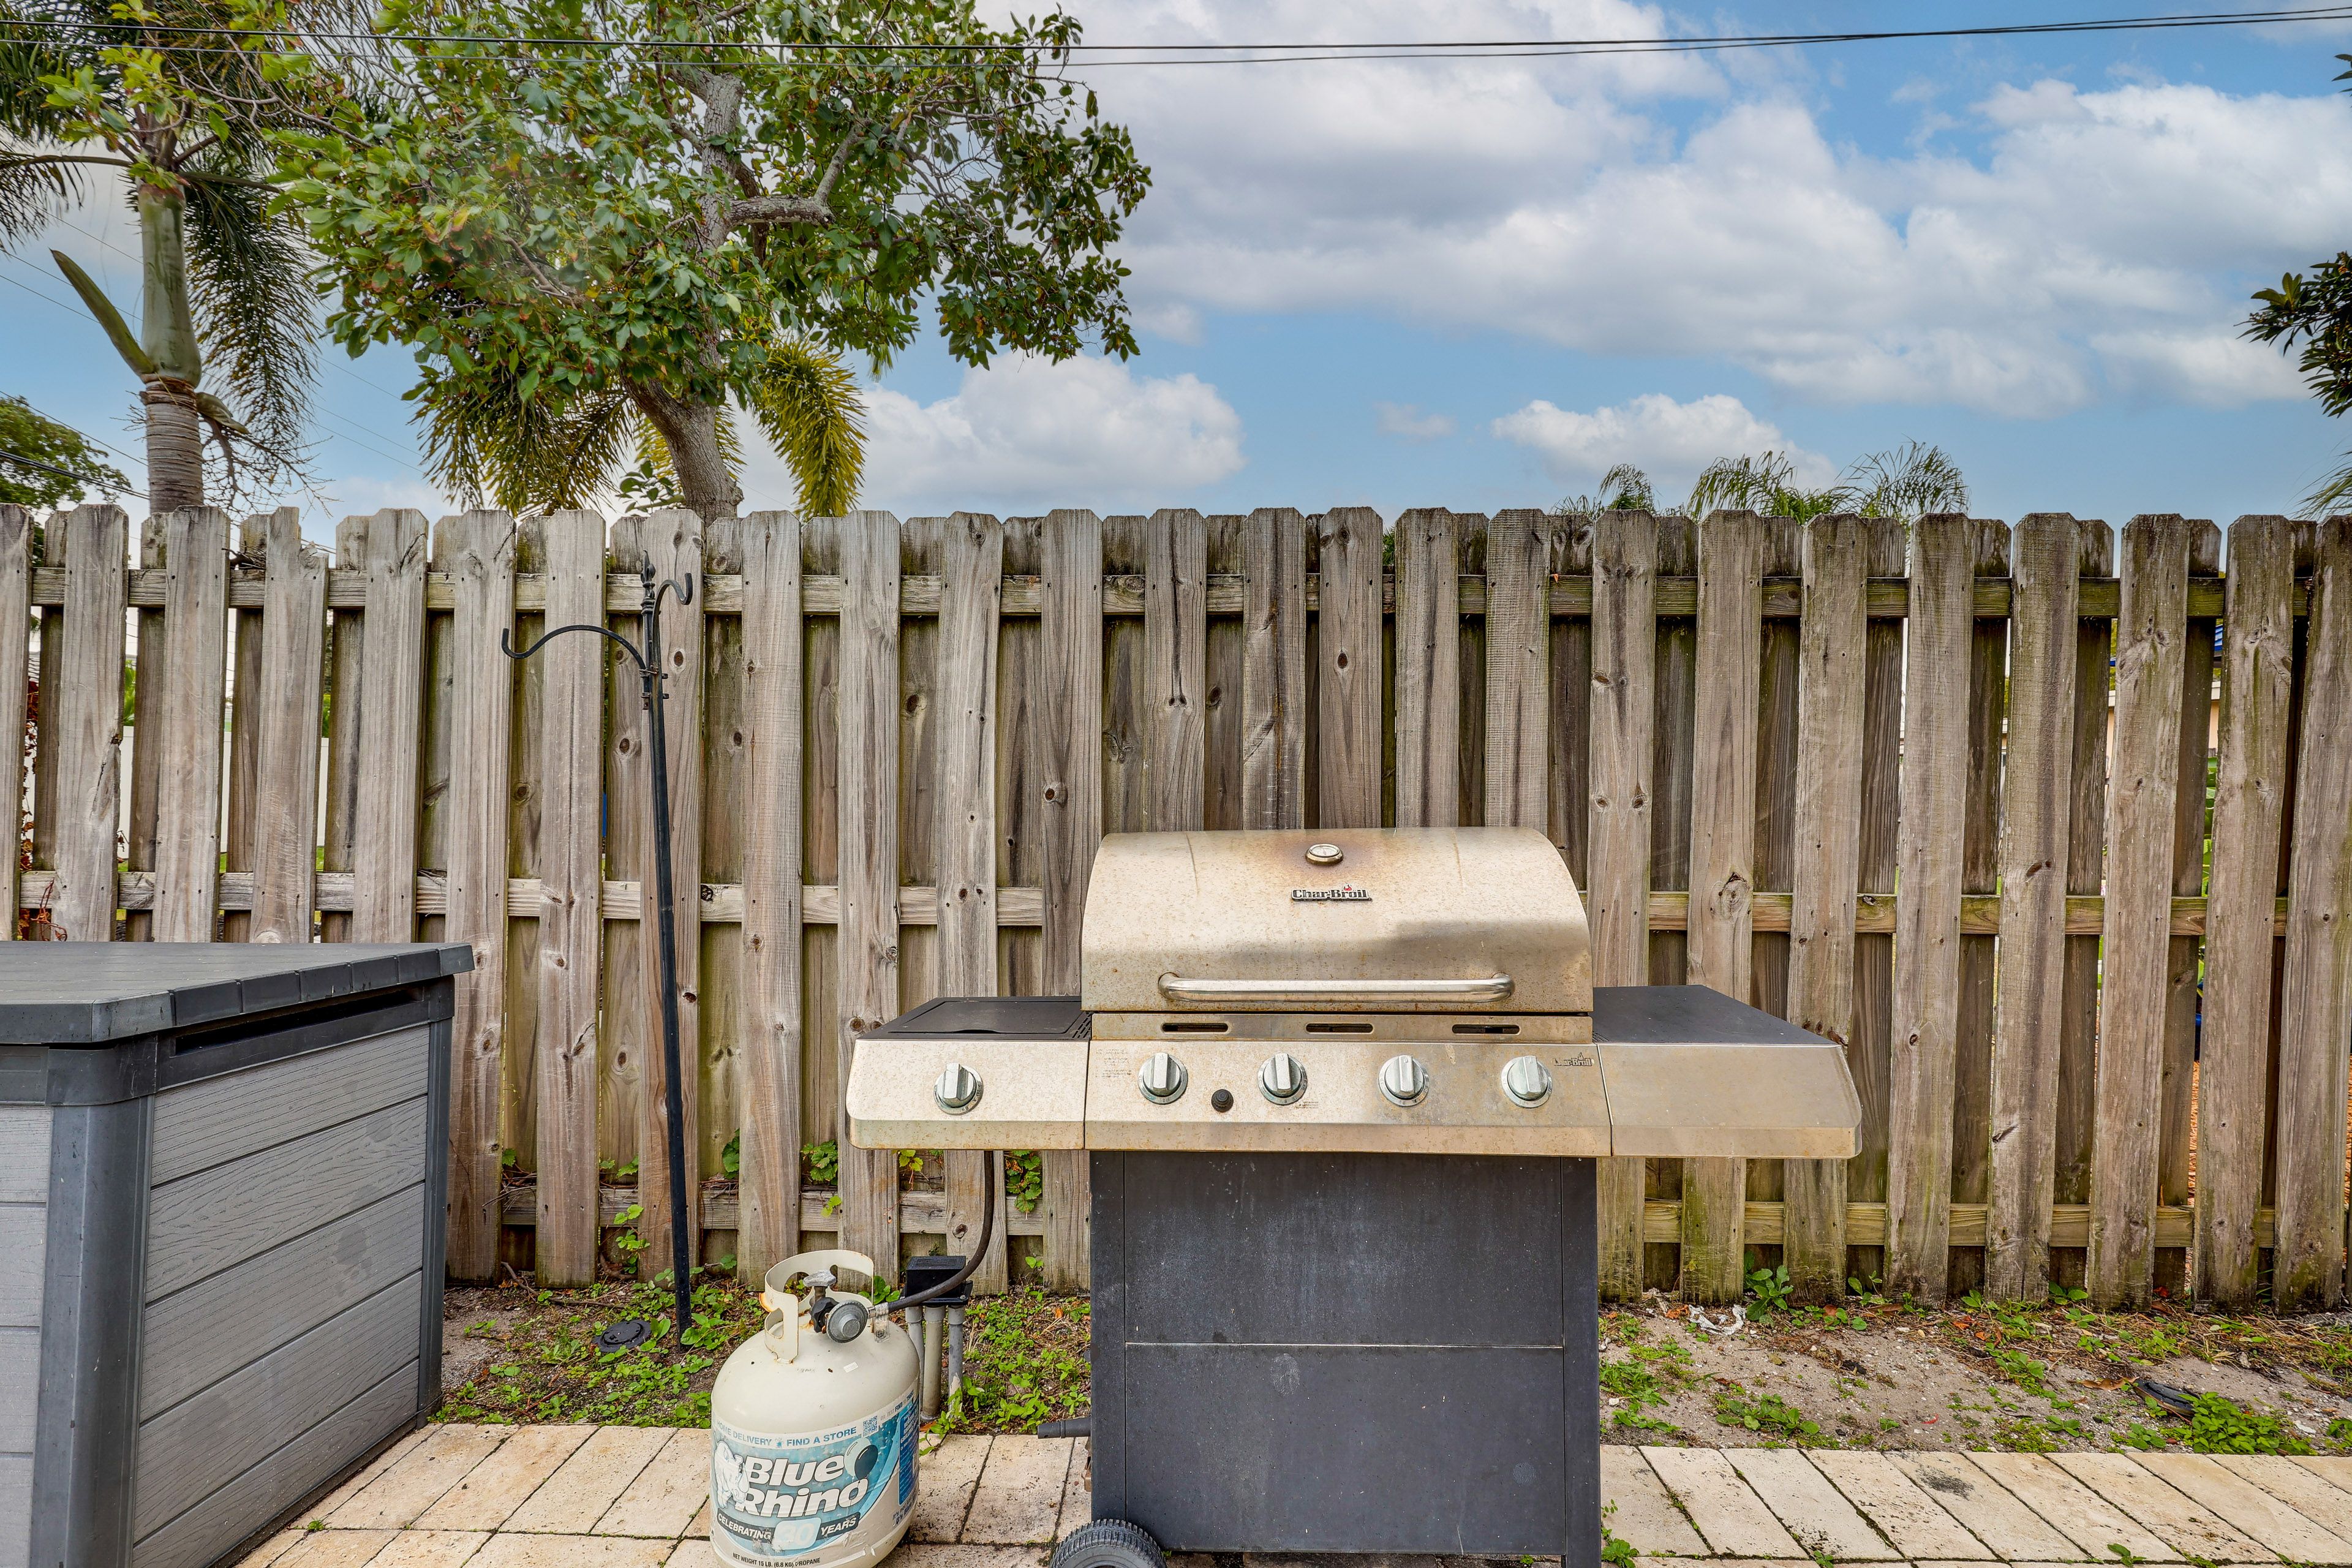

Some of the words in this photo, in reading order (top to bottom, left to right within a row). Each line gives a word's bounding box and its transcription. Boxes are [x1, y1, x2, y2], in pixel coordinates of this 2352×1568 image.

[1292, 889, 1368, 899] Char-Broil
[717, 1420, 732, 1436] HOME
[733, 1431, 772, 1446] DELIVERY
[786, 1438, 810, 1447] FIND
[813, 1436, 821, 1444] A
[823, 1426, 857, 1442] STORE
[745, 1455, 845, 1487] Blue
[734, 1477, 869, 1518] Rhino
[717, 1513, 772, 1540] CELEBRATING
[821, 1517, 857, 1536] YEARS
[741, 1556, 758, 1565] WEIGHT
